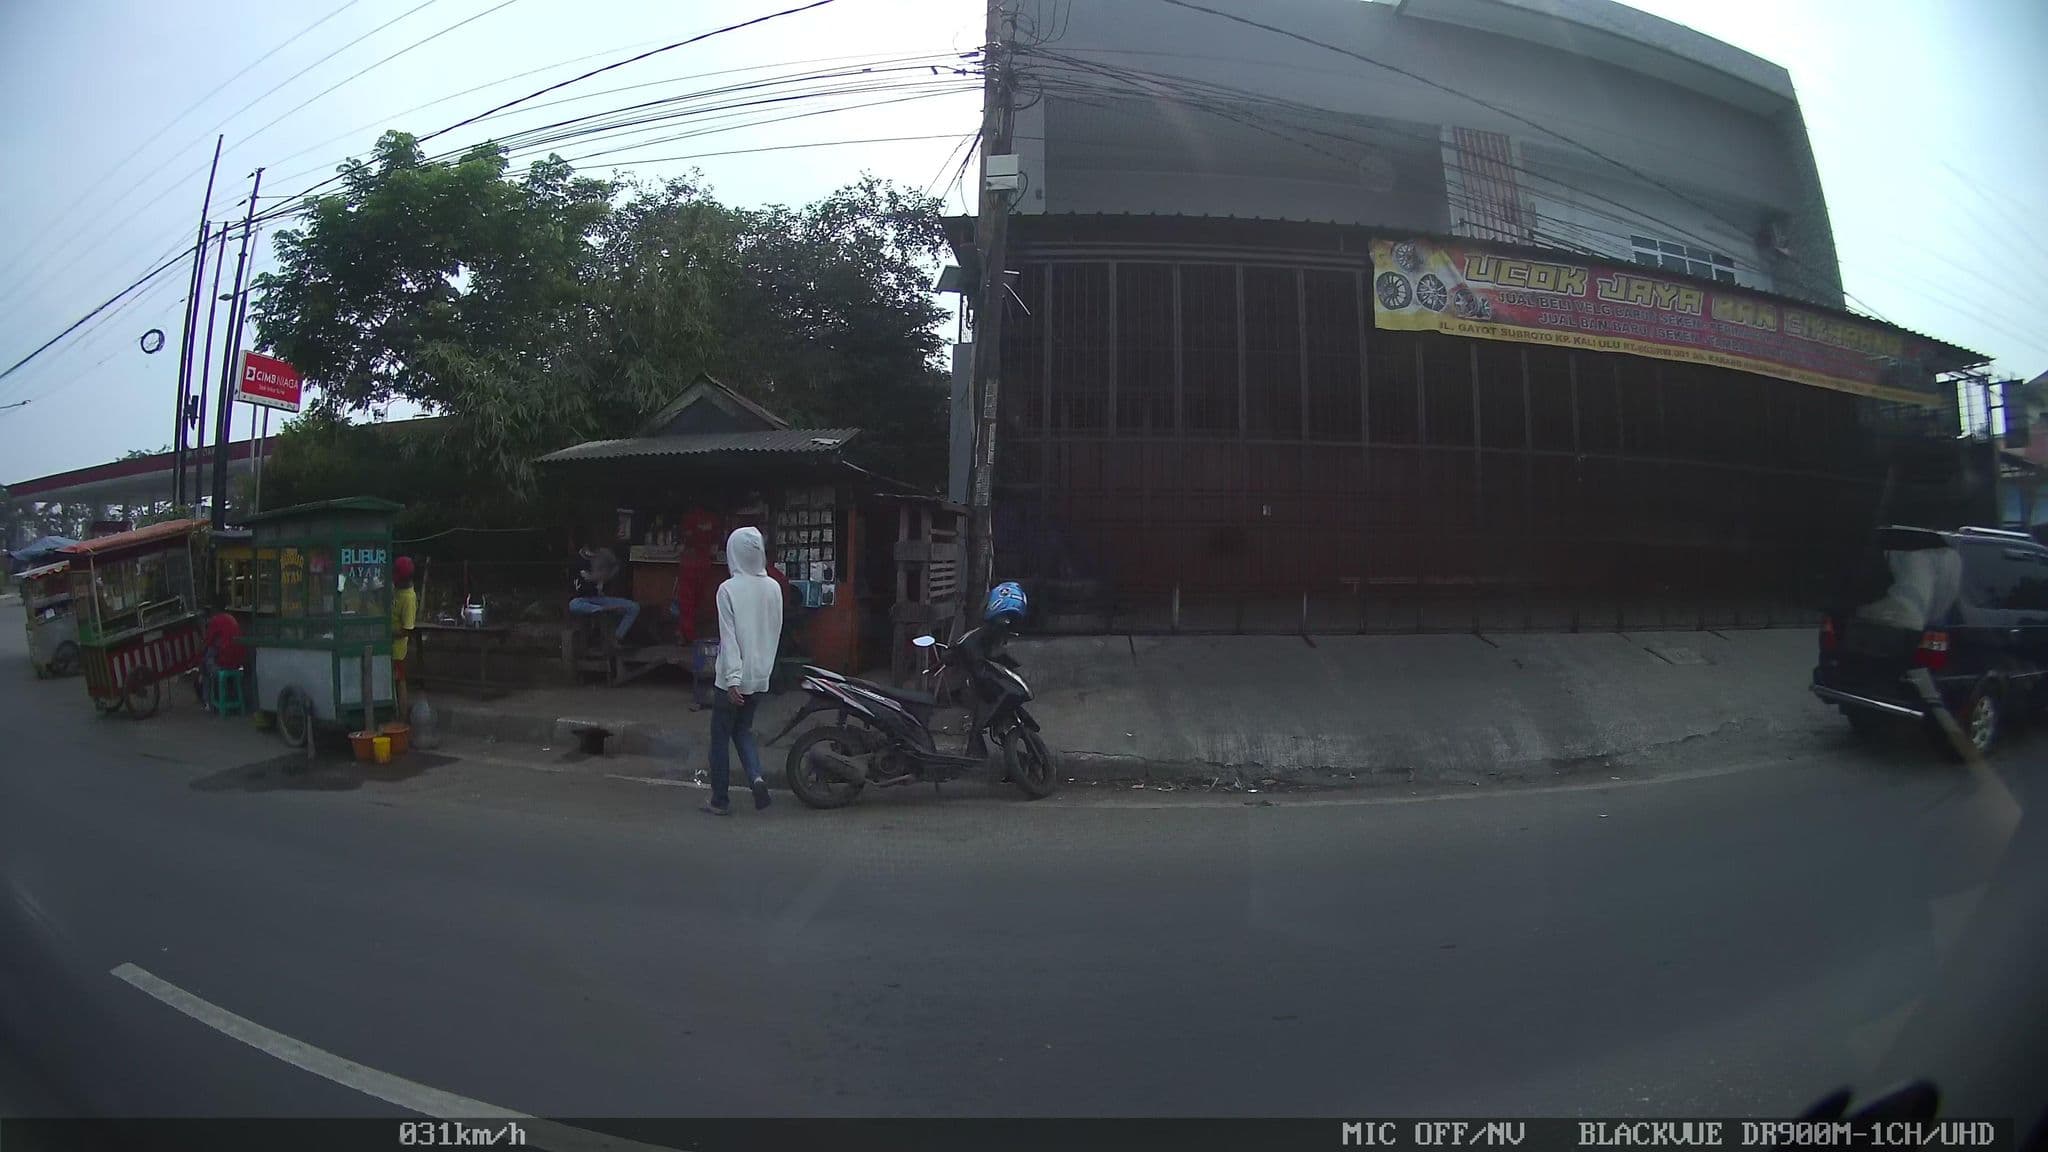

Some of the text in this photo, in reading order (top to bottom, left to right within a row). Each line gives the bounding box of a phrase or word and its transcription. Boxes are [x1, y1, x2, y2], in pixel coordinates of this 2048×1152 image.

[1464, 254, 1589, 297] UCOK
[1597, 273, 1704, 316] JAYA
[1498, 291, 1534, 307] JUAL
[1538, 297, 1571, 311] BELI
[1575, 301, 1611, 316] VELG
[1538, 312, 1576, 327] JUAL
[1580, 318, 1608, 331] BAN
[1500, 328, 1553, 341] SUBROTO
[277, 376, 298, 389] NIAGA
[341, 548, 387, 564] BUBUR
[349, 566, 381, 577] AYAM
